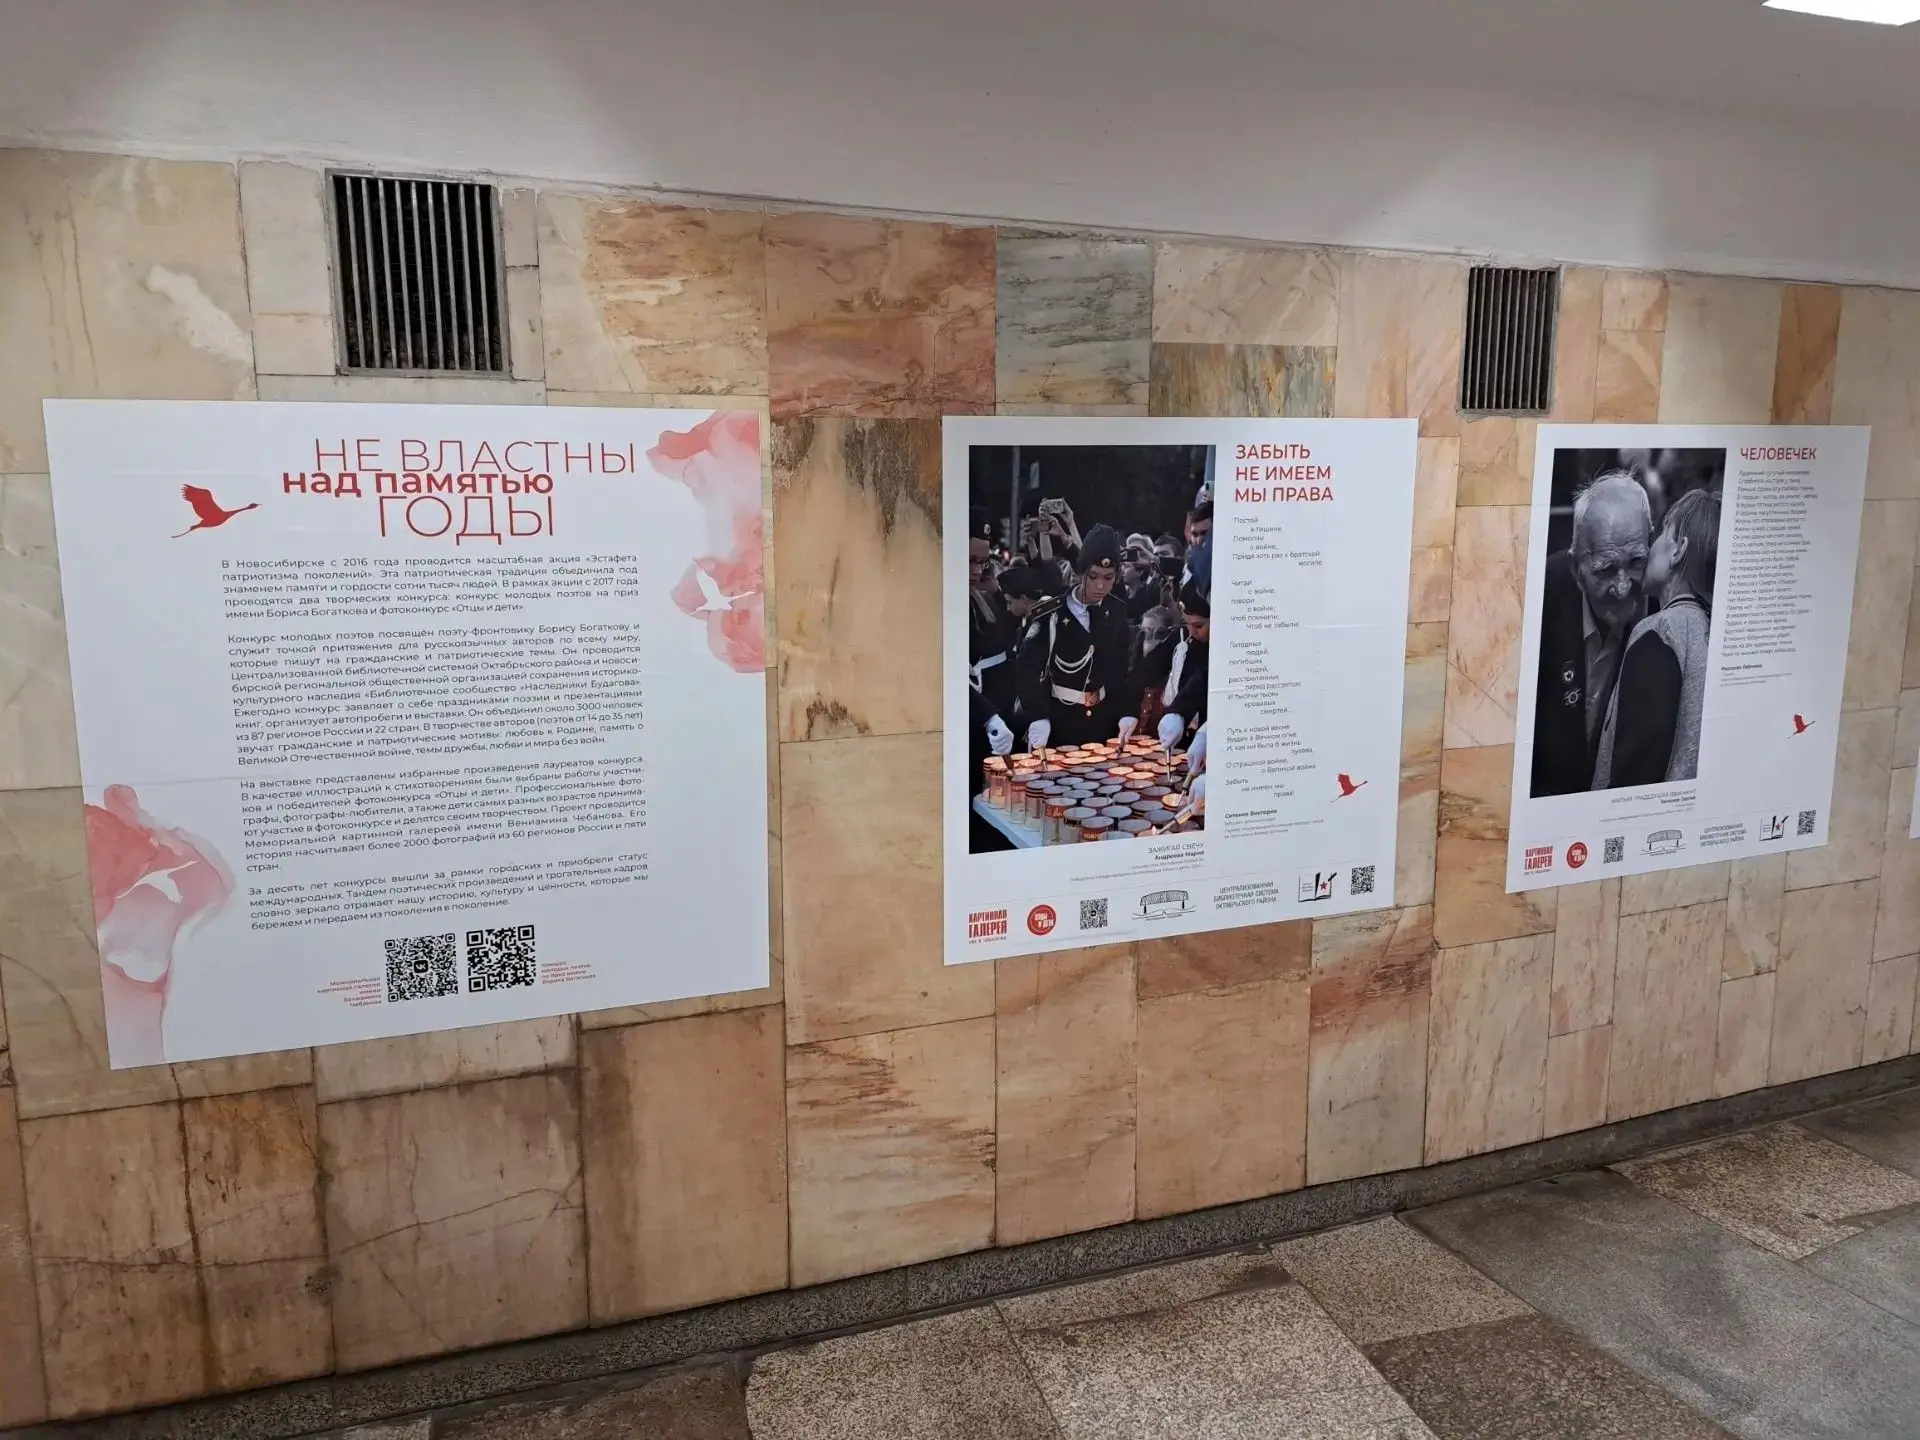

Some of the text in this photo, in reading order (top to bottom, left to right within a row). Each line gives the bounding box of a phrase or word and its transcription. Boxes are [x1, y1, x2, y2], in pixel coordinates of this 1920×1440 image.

[315, 438, 635, 474] НЕ ВЛАСТНЫ
[1235, 444, 1311, 460] ЗАБЫТЬ
[1740, 447, 1817, 460] ЧЕЛОВЕЧЕК
[283, 471, 554, 497] над памятью
[1236, 465, 1331, 481] НЕ ИМЕЕМ
[1235, 486, 1334, 502] МЫ ПРАВА
[379, 495, 554, 546] ГОДЫ
[221, 560, 229, 569] В
[236, 558, 325, 570] Новосибирске
[343, 558, 368, 566] 2016
[373, 559, 399, 567] года
[404, 557, 471, 566] проводится
[476, 555, 543, 564] масштабная
[548, 556, 580, 564] акция
[585, 553, 636, 563] «Эстафета
[222, 573, 298, 583] патриотизма
[380, 569, 399, 578] Эта
[404, 569, 492, 578] патриотическая
[497, 568, 547, 576] традиция
[551, 565, 614, 575] объединила
[618, 566, 637, 574] под
[224, 598, 293, 607] проводятся
[298, 597, 319, 605] два
[325, 595, 391, 605] творческих
[455, 592, 499, 601] конкурс
[505, 591, 551, 600] молодых
[225, 610, 264, 618] имени
[266, 607, 309, 618] Бориса
[310, 606, 368, 616] Богаткова
[378, 603, 449, 615] фотоконкурс
[451, 602, 484, 612] «Отцы
[227, 633, 276, 645] Конкурс
[280, 633, 331, 643] молодых
[336, 632, 374, 640] поэтов
[437, 625, 534, 637] поэту-фронтовику
[538, 623, 575, 633] Борису
[579, 621, 629, 632] Богаткову
[231, 667, 343, 682] Централизованной
[344, 663, 425, 675] библиотечной
[427, 661, 478, 671] системой
[480, 658, 552, 670] Октябрьского
[554, 656, 591, 667] района
[232, 695, 303, 706] культурного
[307, 692, 361, 702] наследия
[364, 686, 449, 698] «Библиотечное
[452, 683, 516, 695] сообщество
[520, 679, 587, 691] «Наследники
[240, 780, 255, 789] На
[259, 778, 311, 788] выставке
[315, 772, 395, 785] представлены
[399, 766, 460, 779] избранные
[463, 762, 539, 775] произведения
[542, 758, 594, 769] лауреатов
[245, 833, 336, 850] Мемориальной
[341, 828, 403, 842] картинной
[408, 823, 460, 836] галереей
[466, 821, 502, 830] имени
[507, 814, 567, 826] Вениамина
[629, 807, 646, 816] Его
[246, 862, 280, 873] стран.
[345, 886, 387, 899] Тандем
[389, 881, 456, 894] поэтических
[458, 872, 534, 888] произведений
[545, 866, 611, 879] трогательных
[613, 862, 647, 873] кадров
[250, 909, 291, 919] словно
[295, 904, 340, 916] зеркало
[343, 898, 393, 911] отражает
[397, 895, 425, 905] нашу
[428, 890, 476, 902] историю,
[480, 885, 524, 897] культуру
[537, 879, 587, 891] ценности,
[590, 875, 630, 886] которые
